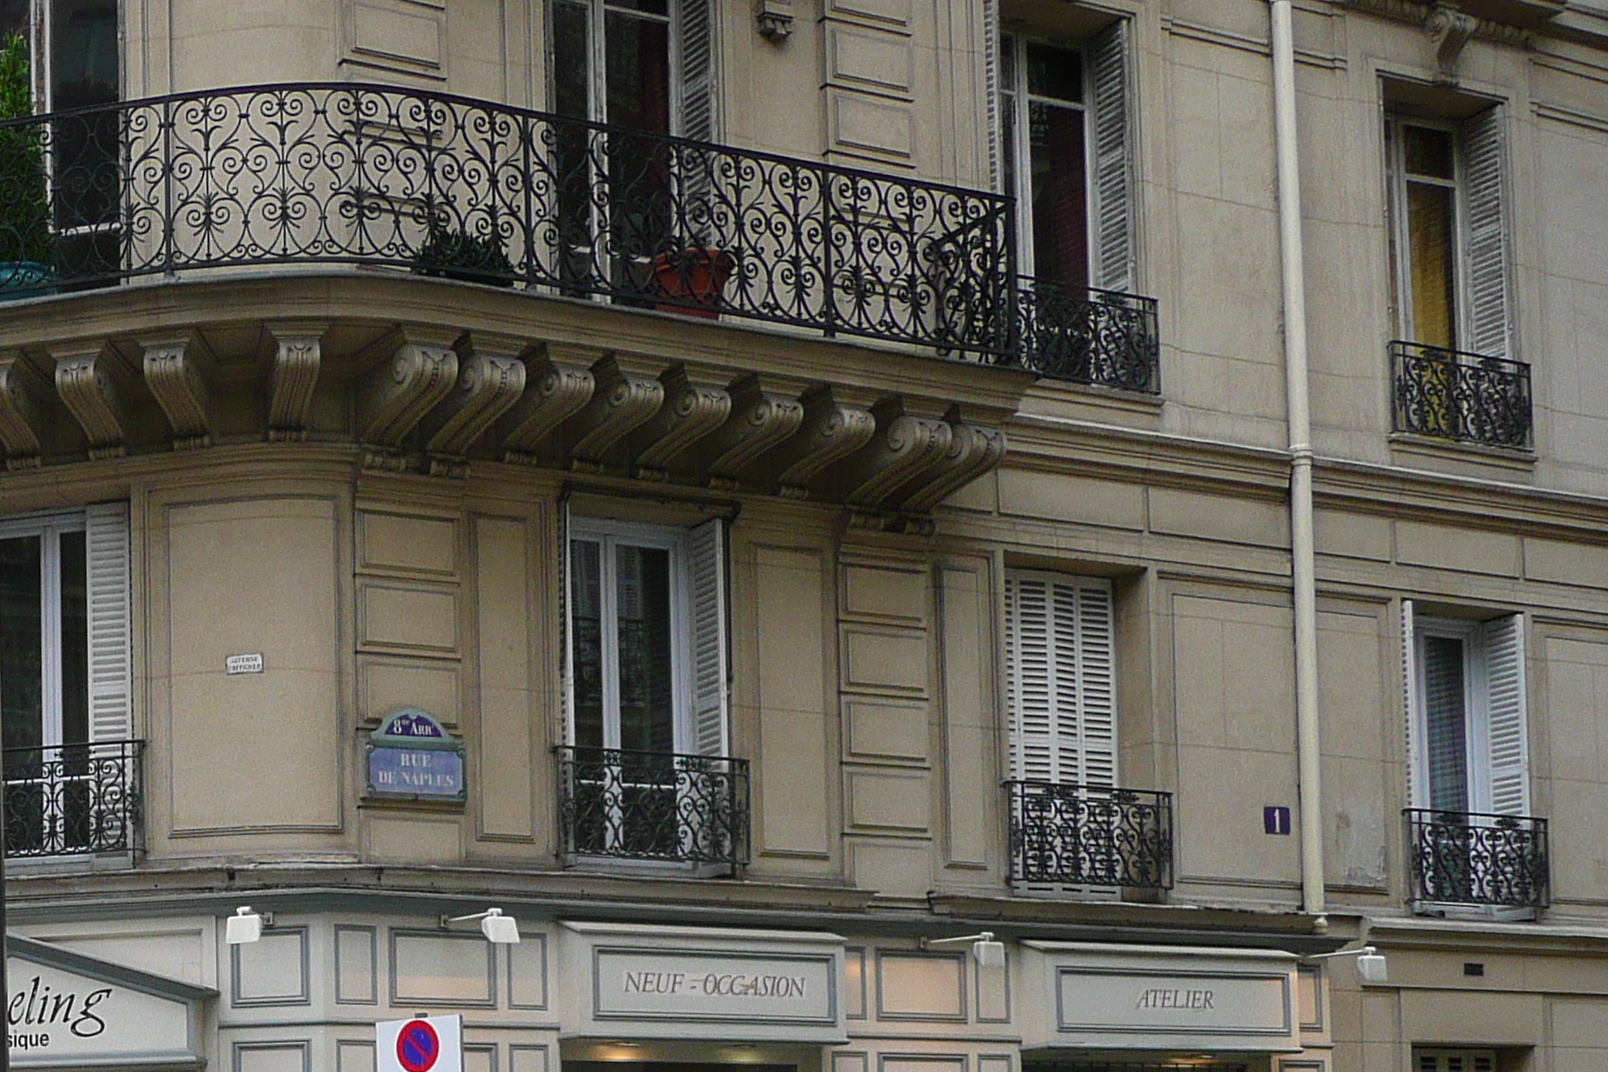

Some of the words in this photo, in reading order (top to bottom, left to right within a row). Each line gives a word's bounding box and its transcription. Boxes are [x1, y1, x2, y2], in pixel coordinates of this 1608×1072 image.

[400, 753, 432, 768] RUE
[378, 770, 396, 784] DE
[402, 771, 454, 787] NAPLES
[623, 971, 685, 994] NEUF
[702, 973, 806, 998] OCCASION
[1134, 988, 1215, 1010] ATELIER
[7, 1030, 50, 1051] sique
